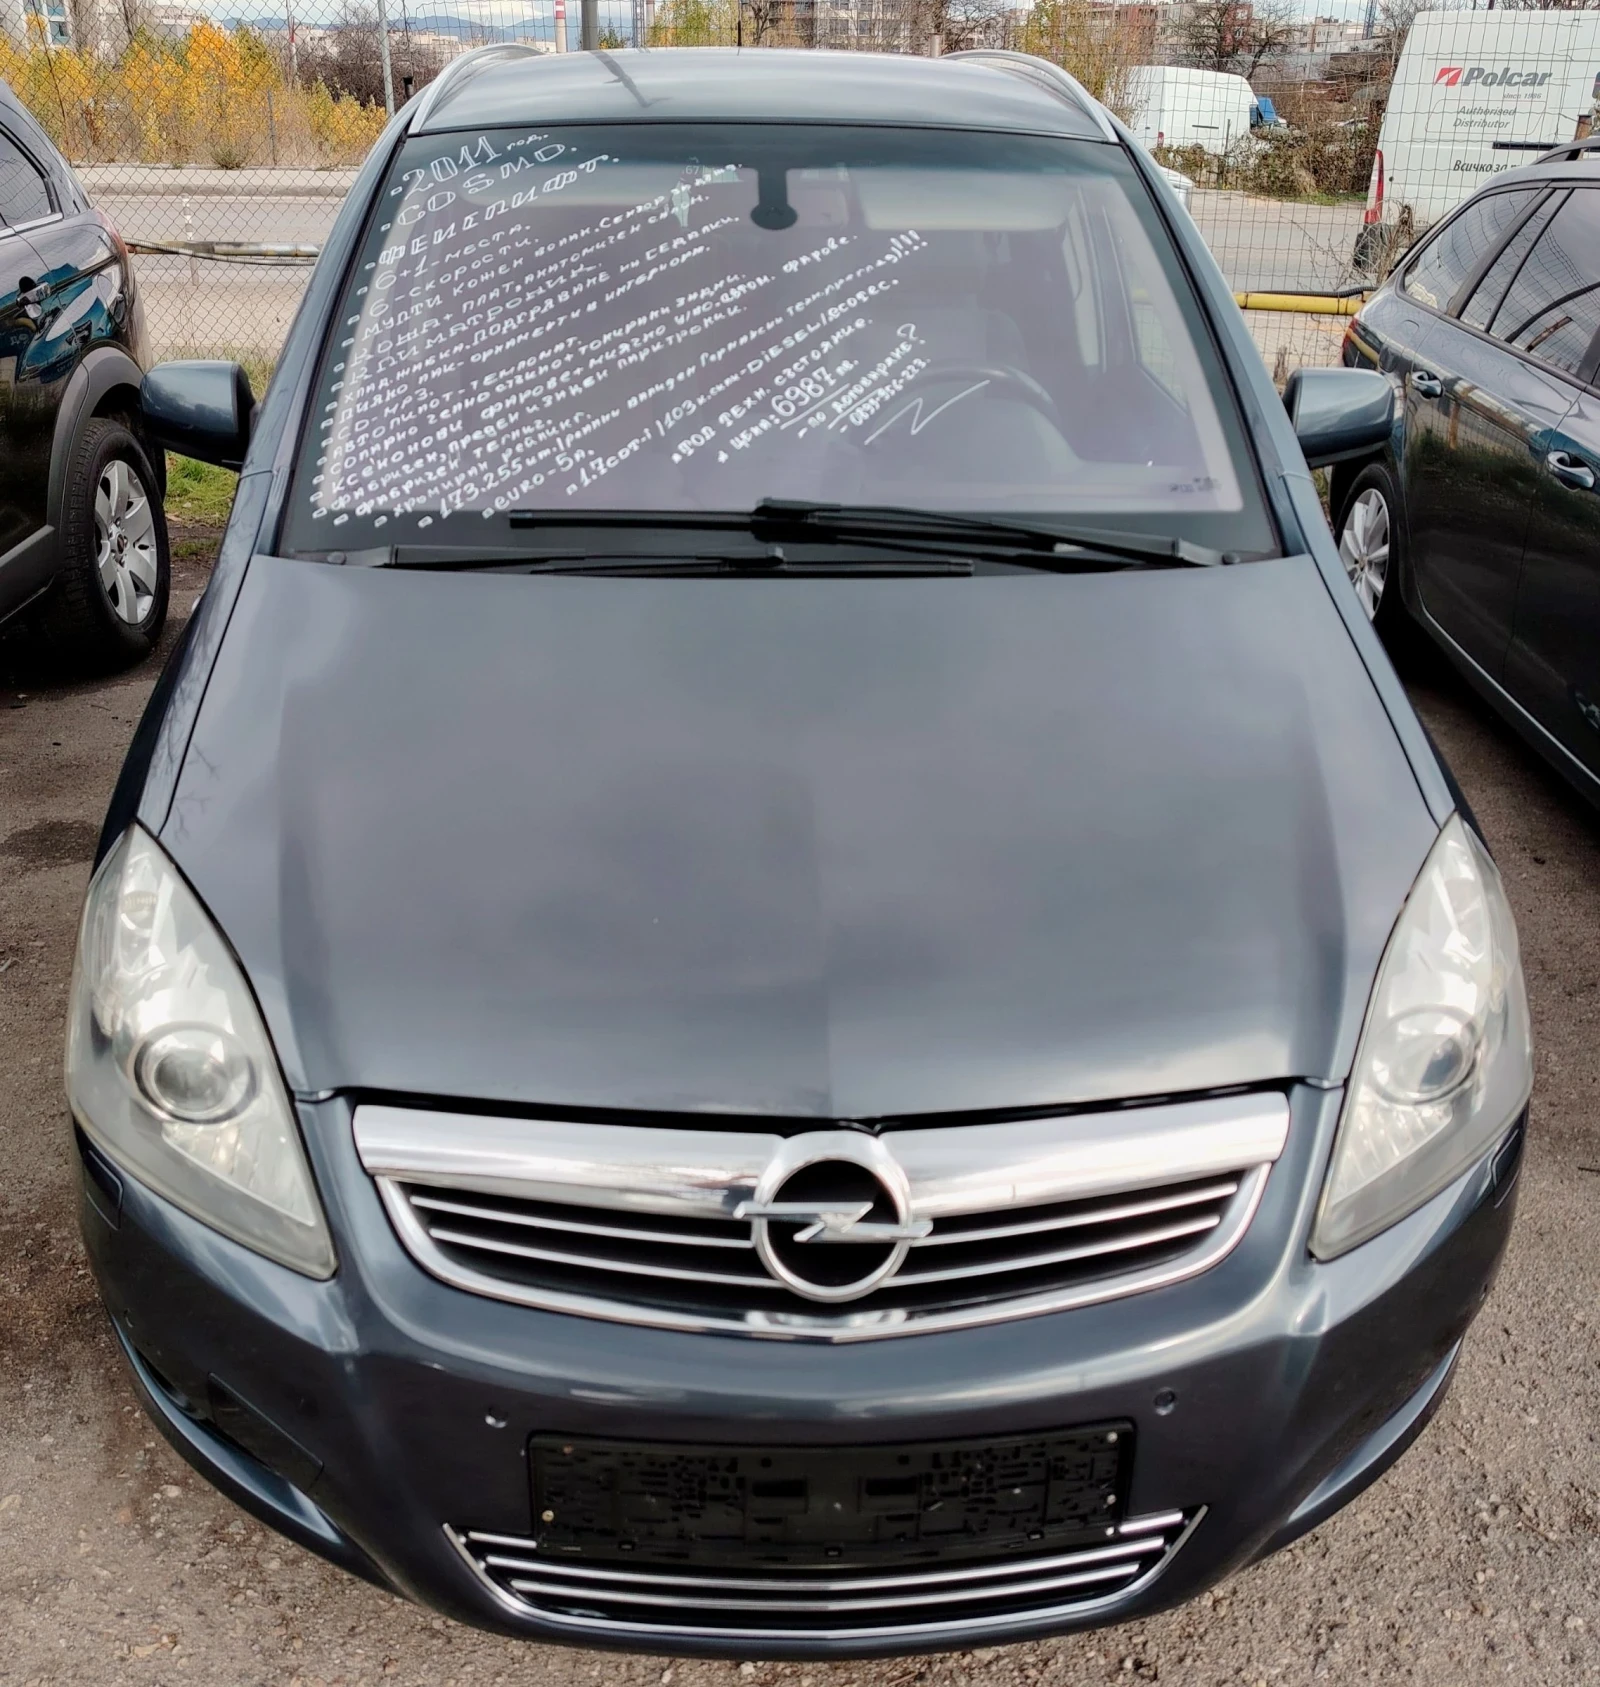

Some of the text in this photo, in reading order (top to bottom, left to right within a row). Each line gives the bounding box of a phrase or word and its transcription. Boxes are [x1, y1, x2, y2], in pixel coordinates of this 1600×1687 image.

[1463, 67, 1553, 87] Polcar
[1457, 105, 1517, 116] Authorised
[1453, 118, 1511, 129] Distributor
[402, 136, 502, 200] 2011
[1453, 159, 1492, 172] Всичко
